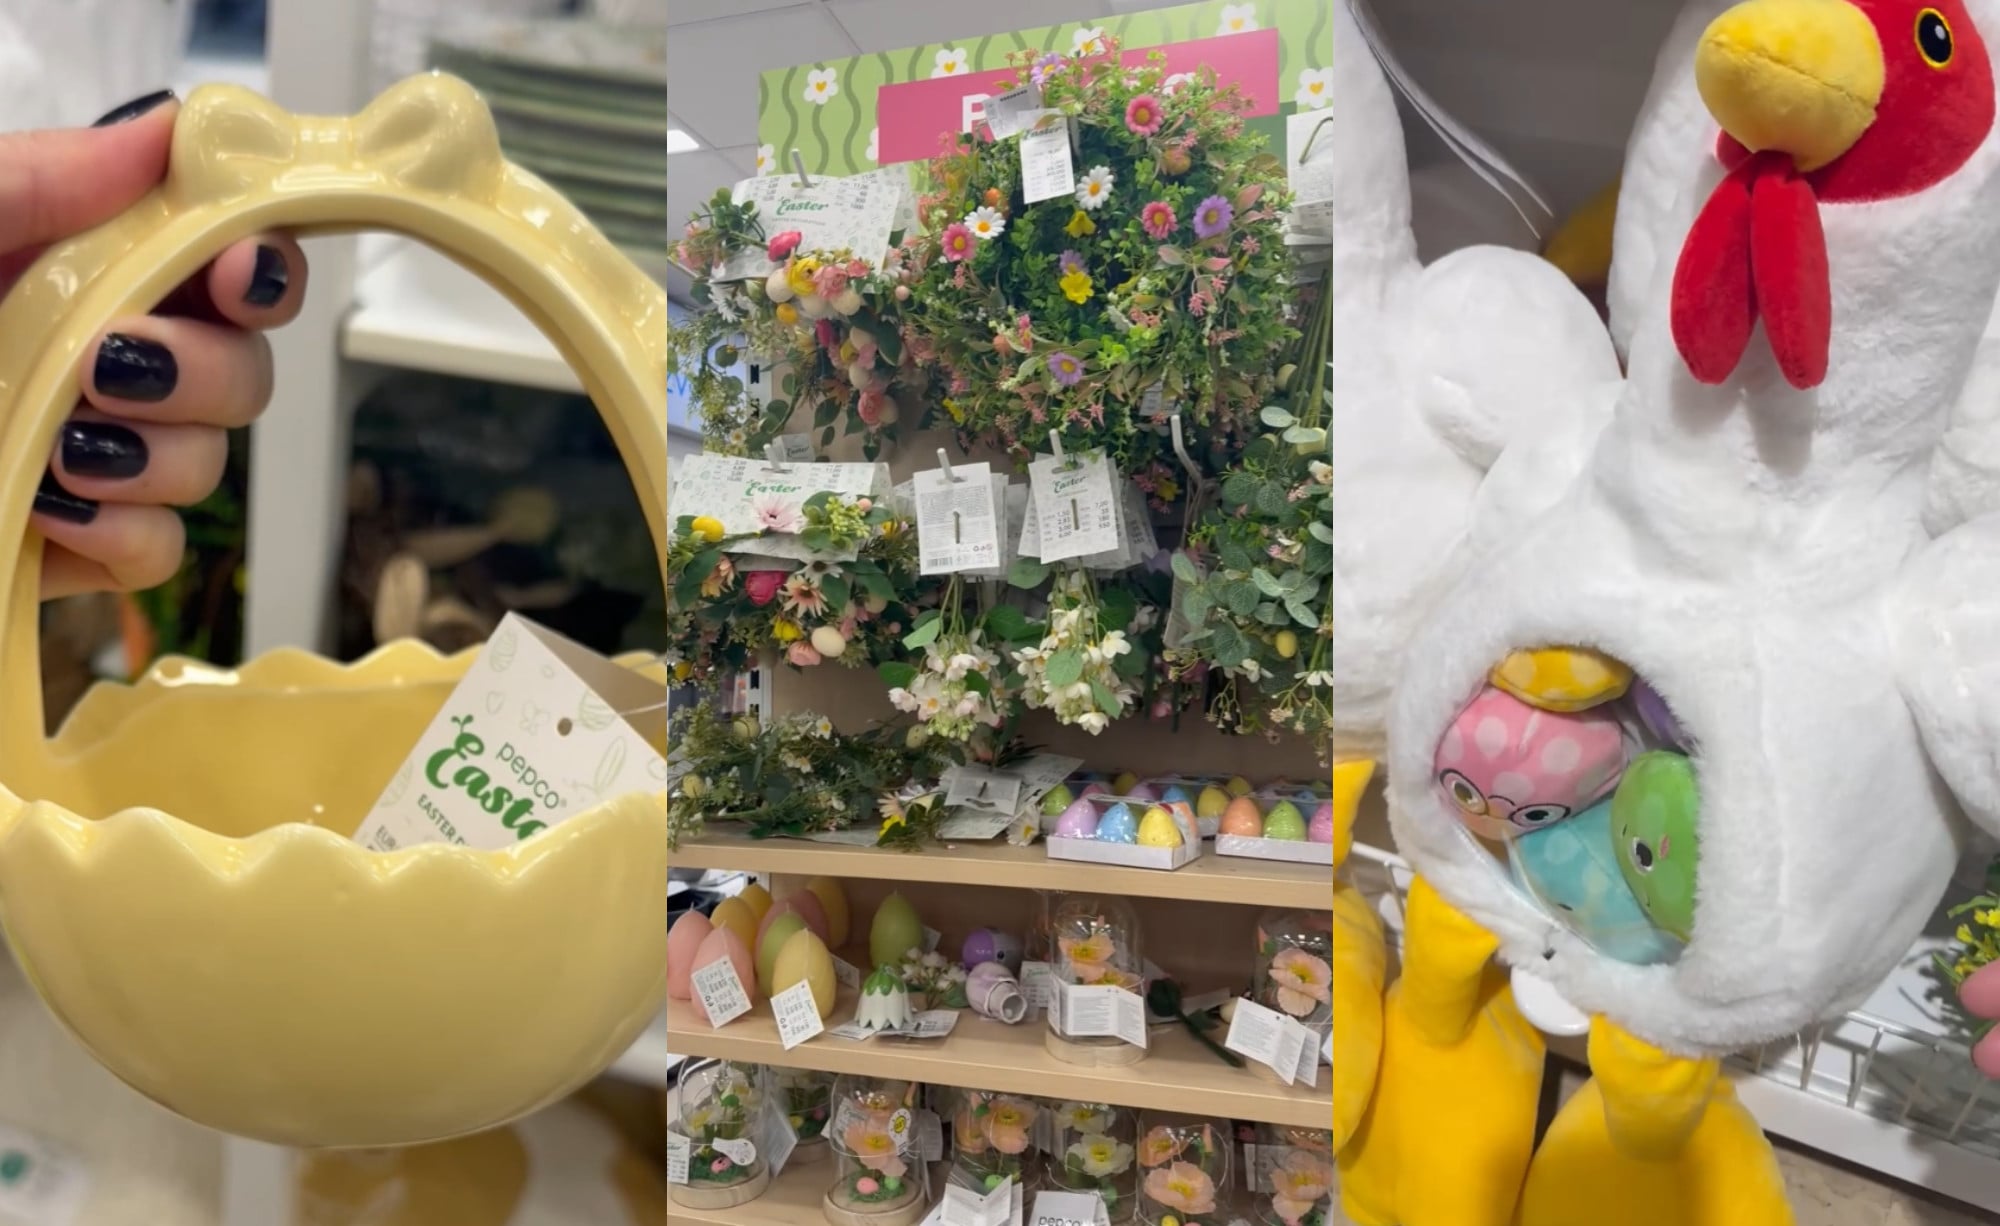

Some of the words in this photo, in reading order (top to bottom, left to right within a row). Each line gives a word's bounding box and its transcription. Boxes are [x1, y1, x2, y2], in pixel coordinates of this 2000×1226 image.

[776, 197, 829, 216] Easter
[744, 480, 802, 497] Easter
[496, 742, 560, 810] pepco
[418, 793, 457, 842] EASTER
